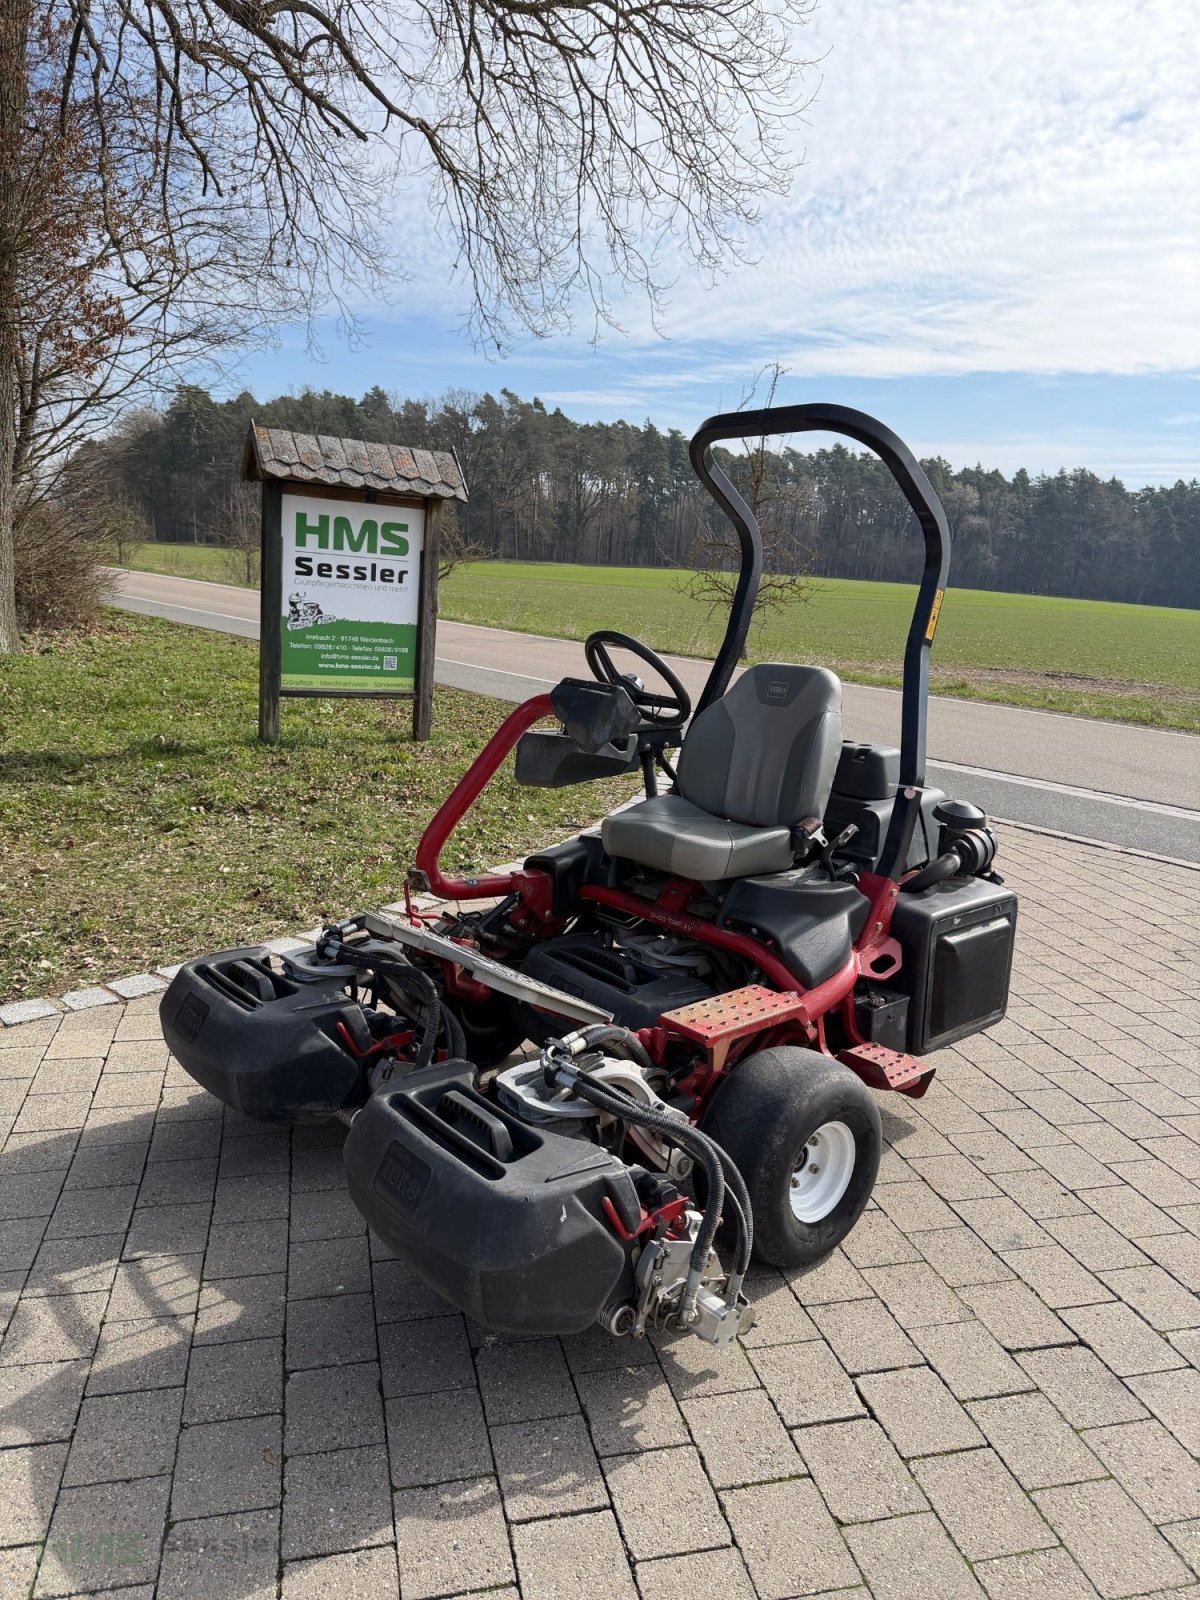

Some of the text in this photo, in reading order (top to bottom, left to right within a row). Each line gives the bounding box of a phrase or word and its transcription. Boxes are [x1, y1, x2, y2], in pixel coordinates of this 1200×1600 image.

[295, 511, 410, 557] HMS
[294, 556, 409, 584] Sessler
[374, 584, 388, 592] und
[318, 662, 381, 671] www.hms-sessler.de
[382, 1156, 420, 1200] TORO
